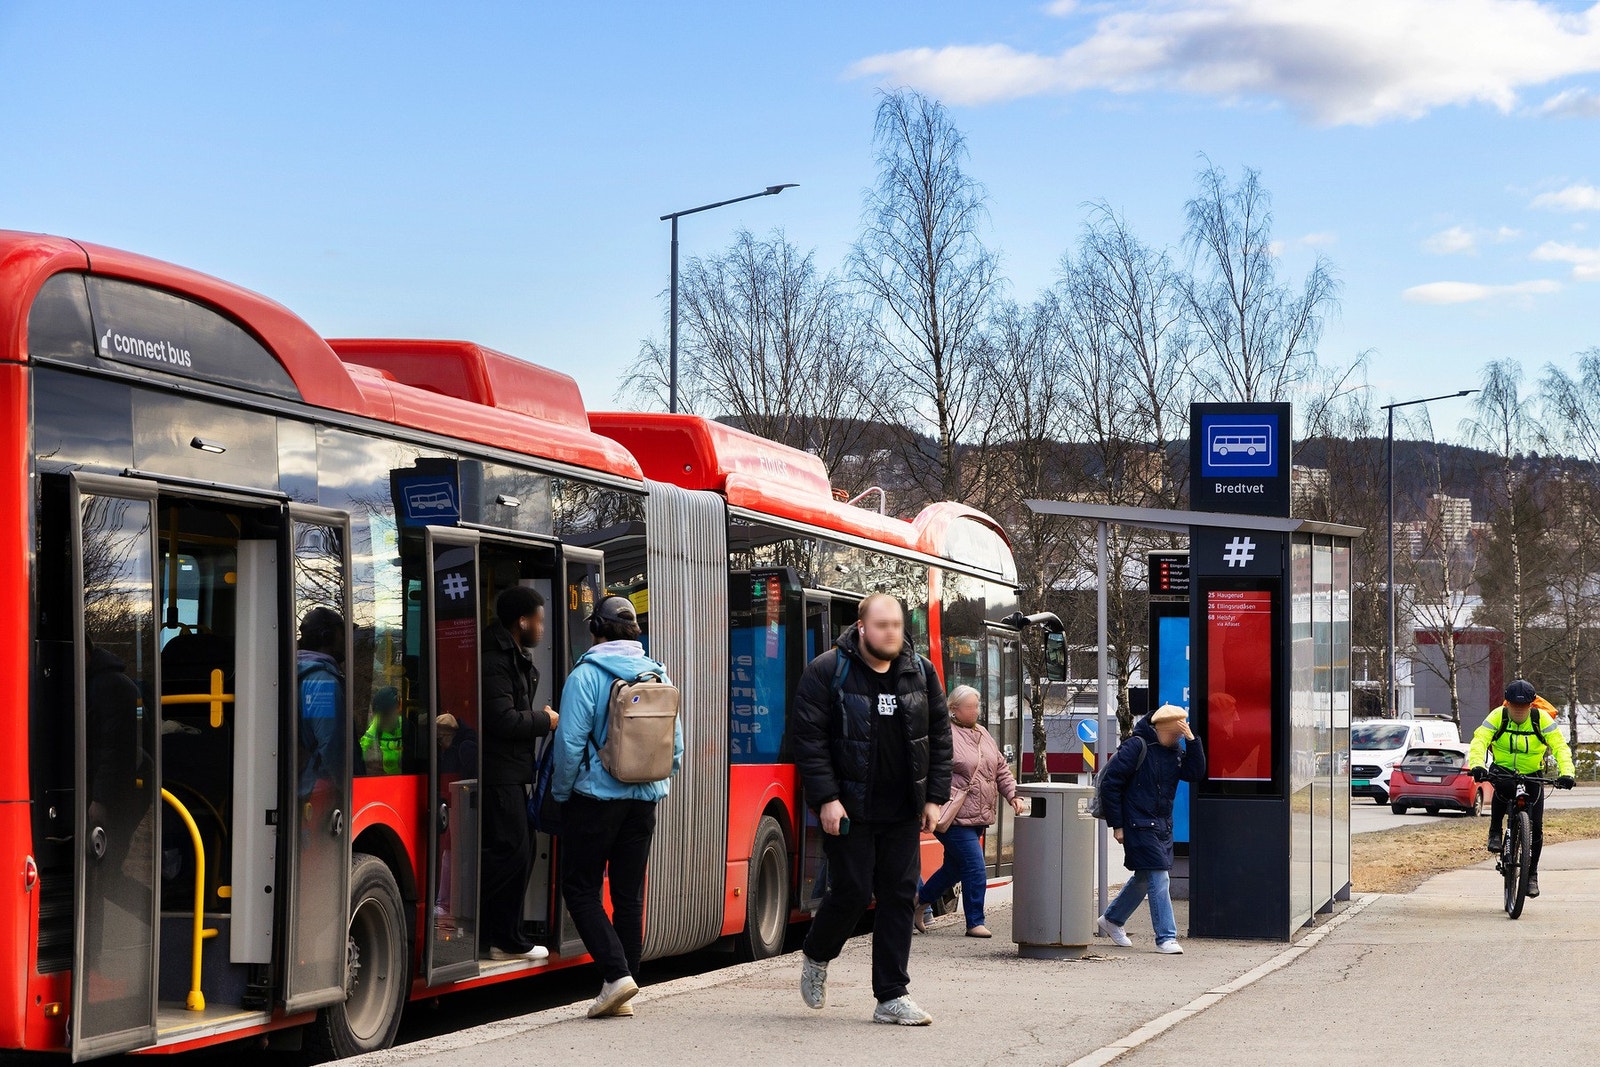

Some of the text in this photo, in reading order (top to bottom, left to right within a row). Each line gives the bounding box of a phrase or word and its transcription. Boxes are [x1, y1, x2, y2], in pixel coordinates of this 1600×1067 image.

[114, 334, 191, 367] connect bus
[1215, 483, 1265, 494] Bredtvet
